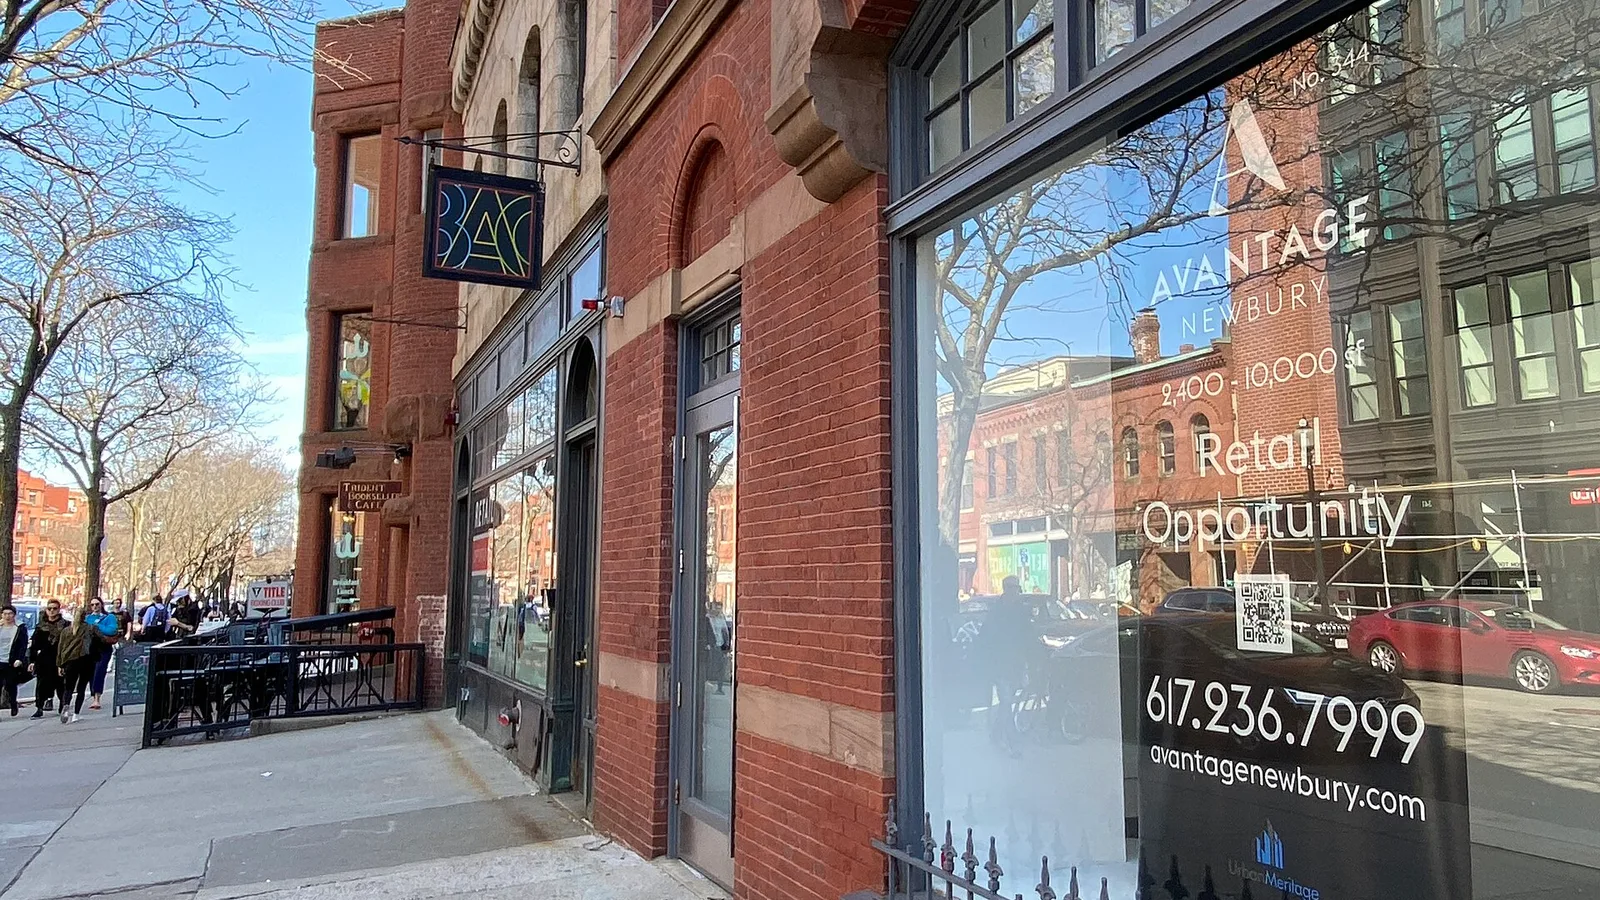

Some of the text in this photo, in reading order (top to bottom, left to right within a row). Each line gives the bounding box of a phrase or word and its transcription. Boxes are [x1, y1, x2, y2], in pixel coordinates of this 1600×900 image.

[1292, 41, 1370, 98] No. 344
[439, 184, 533, 277] BAC
[1150, 195, 1370, 307] AVANTAGE
[1182, 276, 1327, 340] NEWBURY
[1161, 372, 1224, 408] 2,400
[1245, 348, 1338, 391] 10,000
[1199, 416, 1322, 478] Retail
[343, 483, 384, 492] TRIDENT
[1142, 484, 1412, 553] Opportunity
[263, 587, 286, 598] TITLE
[1146, 675, 1426, 764] 617.236.7999
[1150, 744, 1426, 822] avantagenewbury.com
